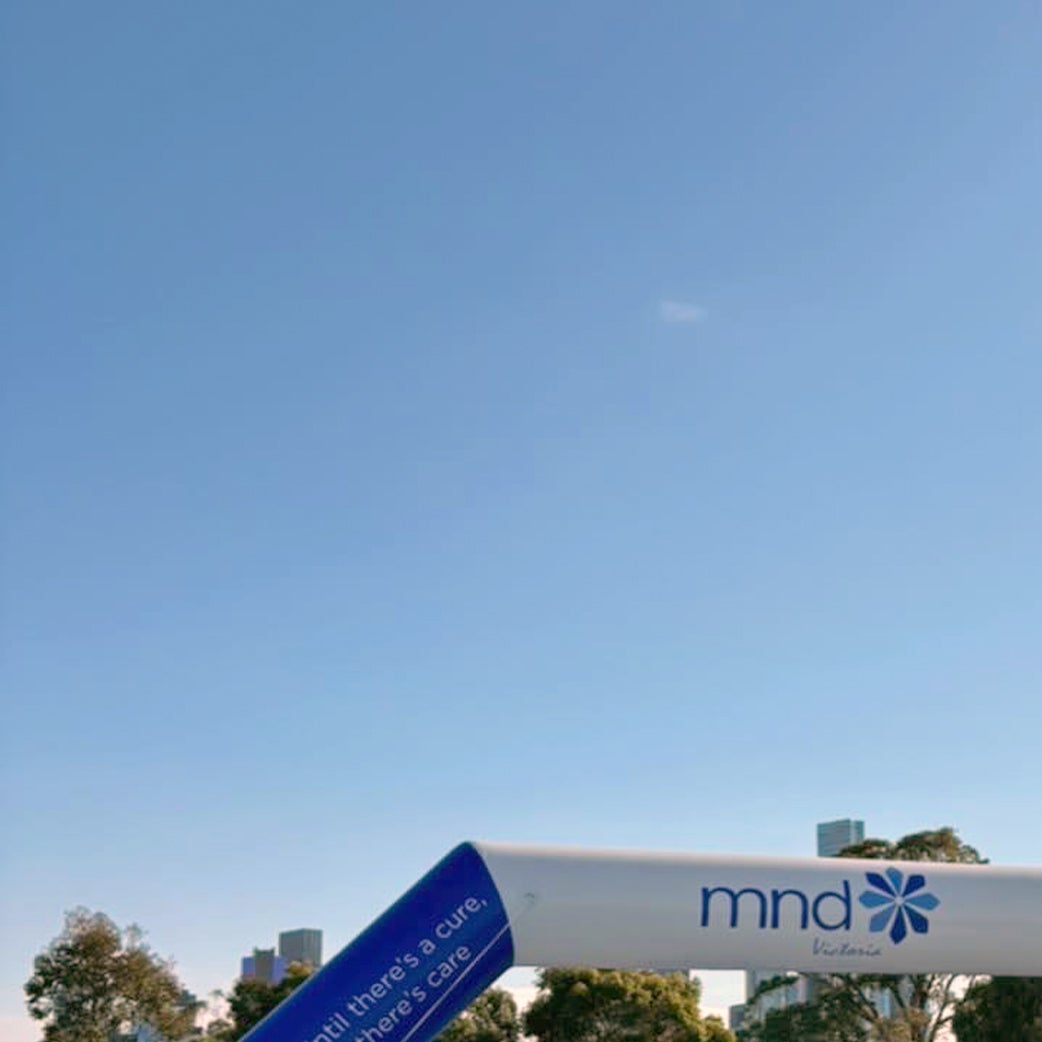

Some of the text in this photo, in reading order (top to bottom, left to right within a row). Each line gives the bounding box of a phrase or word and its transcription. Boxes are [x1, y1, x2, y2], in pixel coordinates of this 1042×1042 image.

[700, 880, 851, 931] mnd
[347, 953, 419, 1017] there's
[417, 938, 436, 956] a
[435, 896, 488, 939] cure,
[427, 946, 472, 987] care
[812, 937, 882, 957] Victoria
